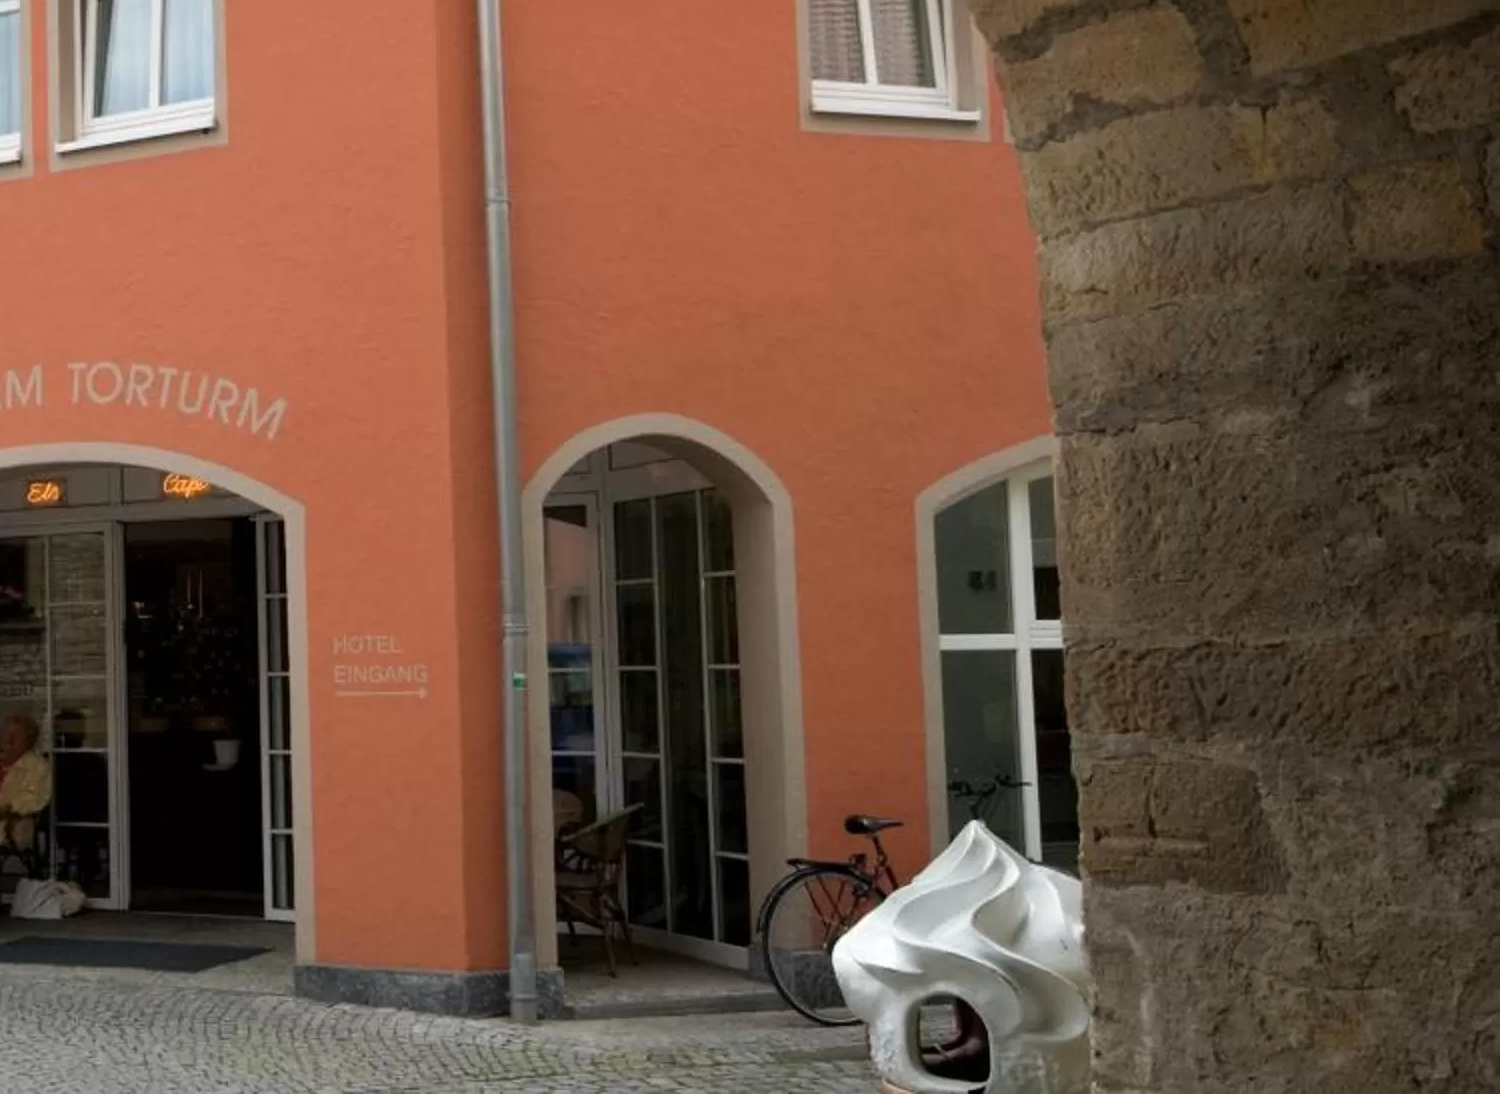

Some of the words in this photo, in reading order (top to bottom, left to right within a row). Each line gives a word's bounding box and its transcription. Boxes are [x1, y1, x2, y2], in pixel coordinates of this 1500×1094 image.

[68, 361, 289, 442] TORTURM
[331, 633, 405, 655] HOTEL
[334, 664, 429, 683] EINGANG
